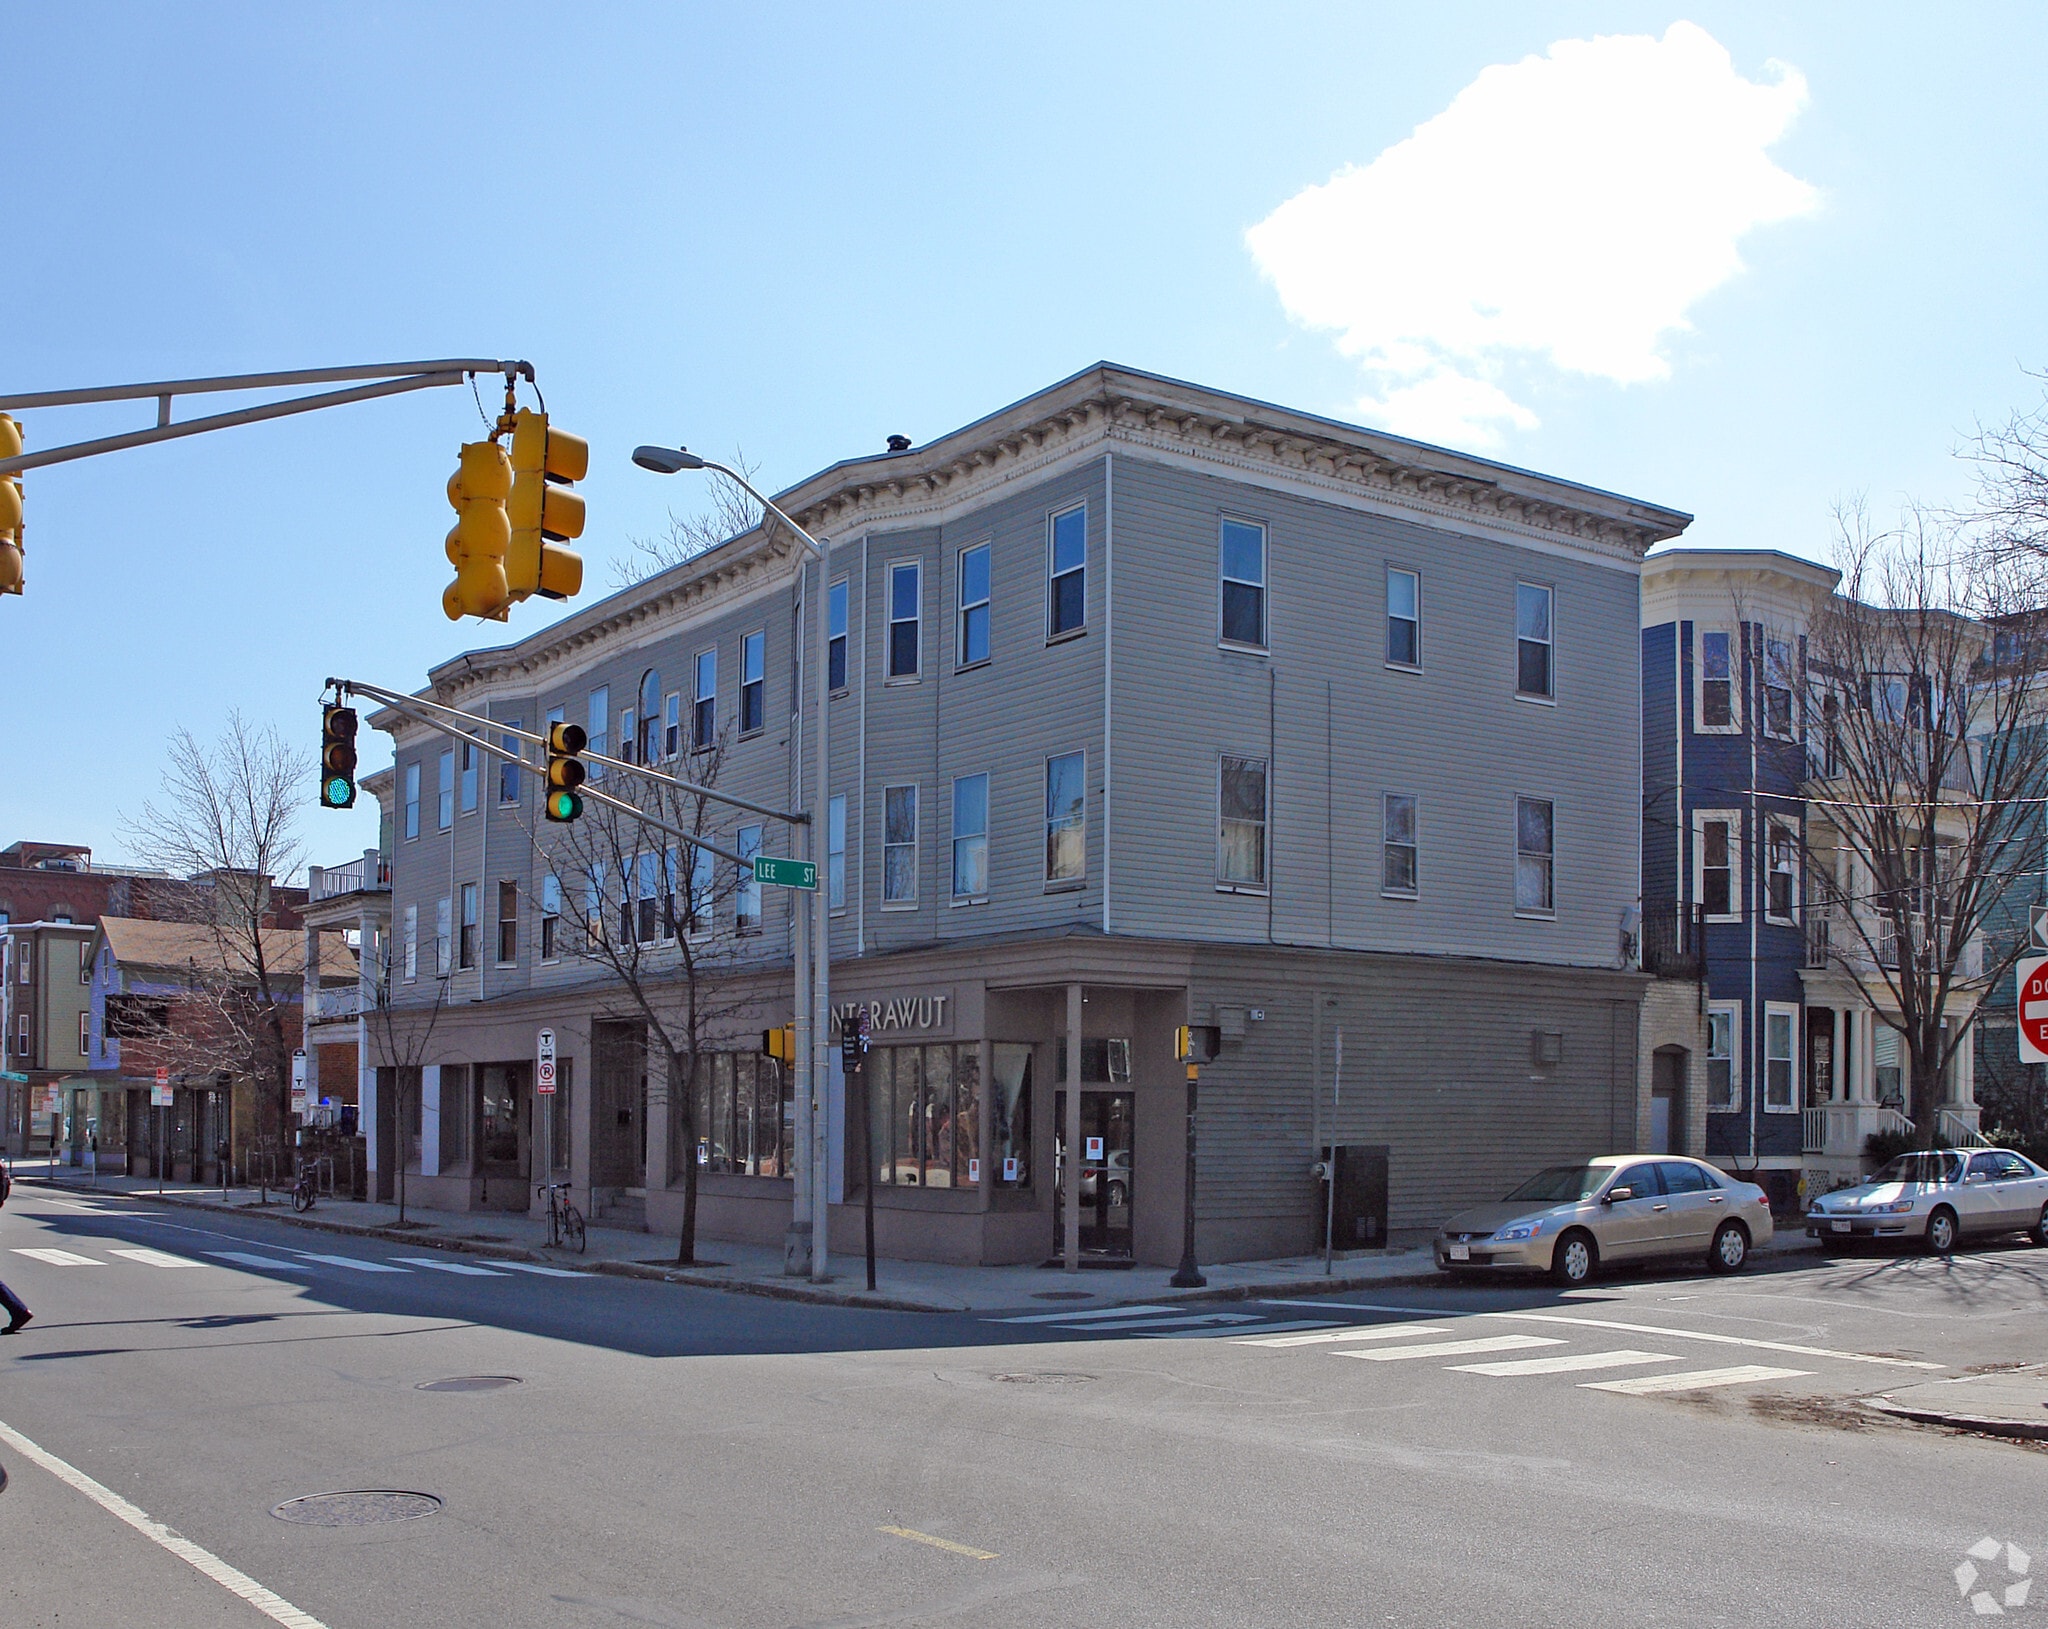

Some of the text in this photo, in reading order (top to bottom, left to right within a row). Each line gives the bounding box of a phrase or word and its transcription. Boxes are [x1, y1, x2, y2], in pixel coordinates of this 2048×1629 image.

[759, 863, 814, 883] LEE ST
[830, 996, 946, 1033] NTRAWUT
[541, 1034, 551, 1044] T
[295, 1078, 303, 1086] T
